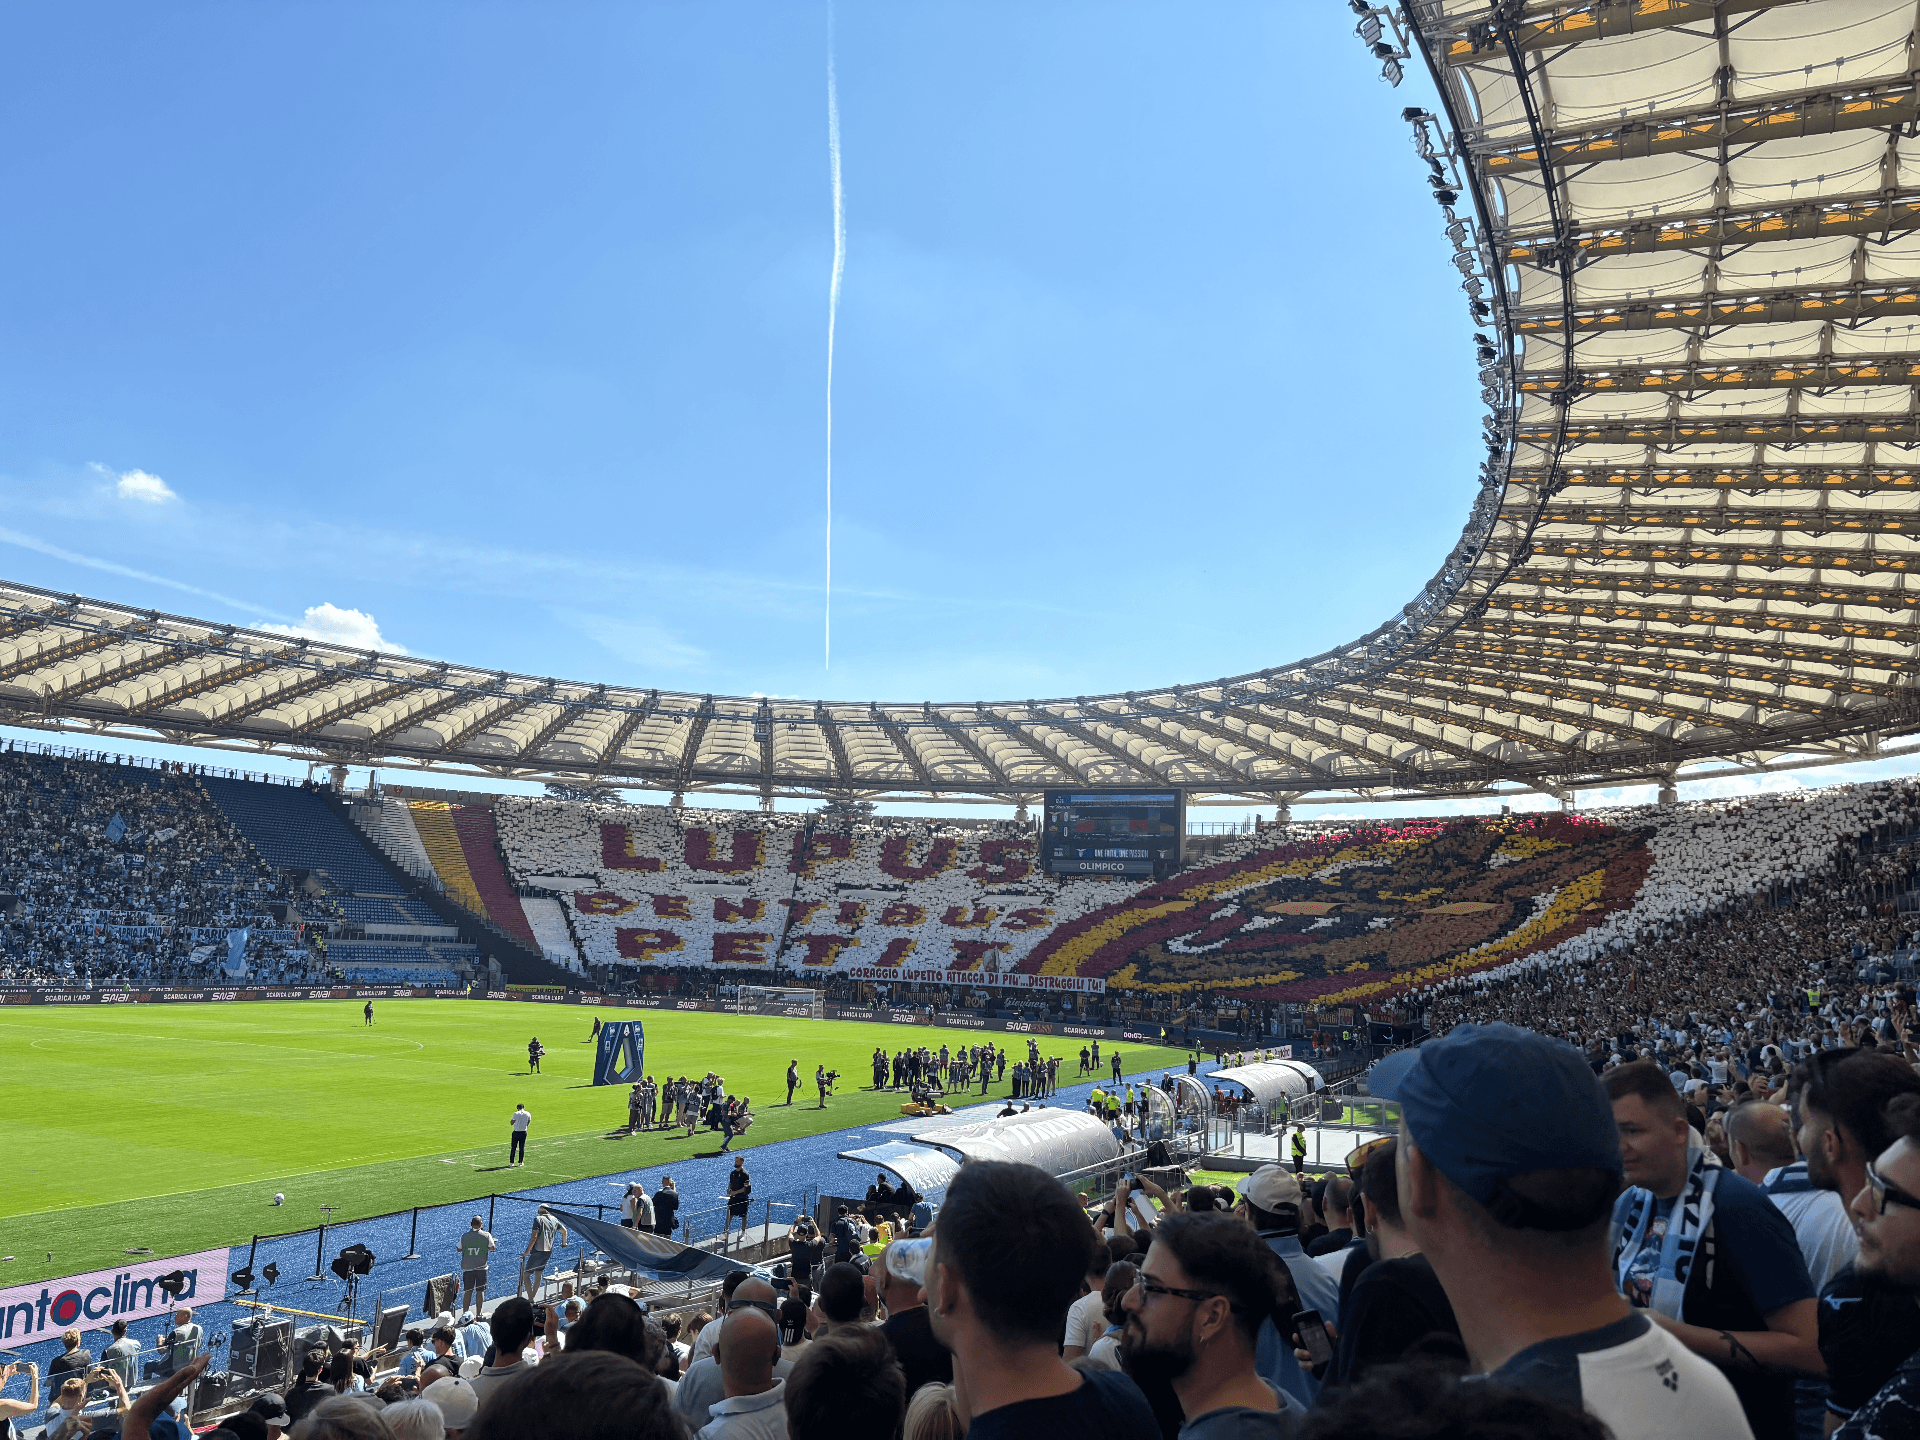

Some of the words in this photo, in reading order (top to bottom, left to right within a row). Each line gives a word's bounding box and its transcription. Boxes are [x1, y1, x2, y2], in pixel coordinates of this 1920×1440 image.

[1079, 862, 1125, 871] OLIMPICO
[850, 968, 898, 978] CORAGGIO
[902, 969, 943, 981] LUPETTO
[946, 971, 984, 984] ATTACCA
[988, 972, 998, 984] DI
[1088, 978, 1102, 992] TU!
[1064, 1026, 1088, 1035] SCARICA
[1089, 1028, 1105, 1036] L'APP
[1004, 1115, 1100, 1146] MIZUNO
[468, 1247, 480, 1256] TV
